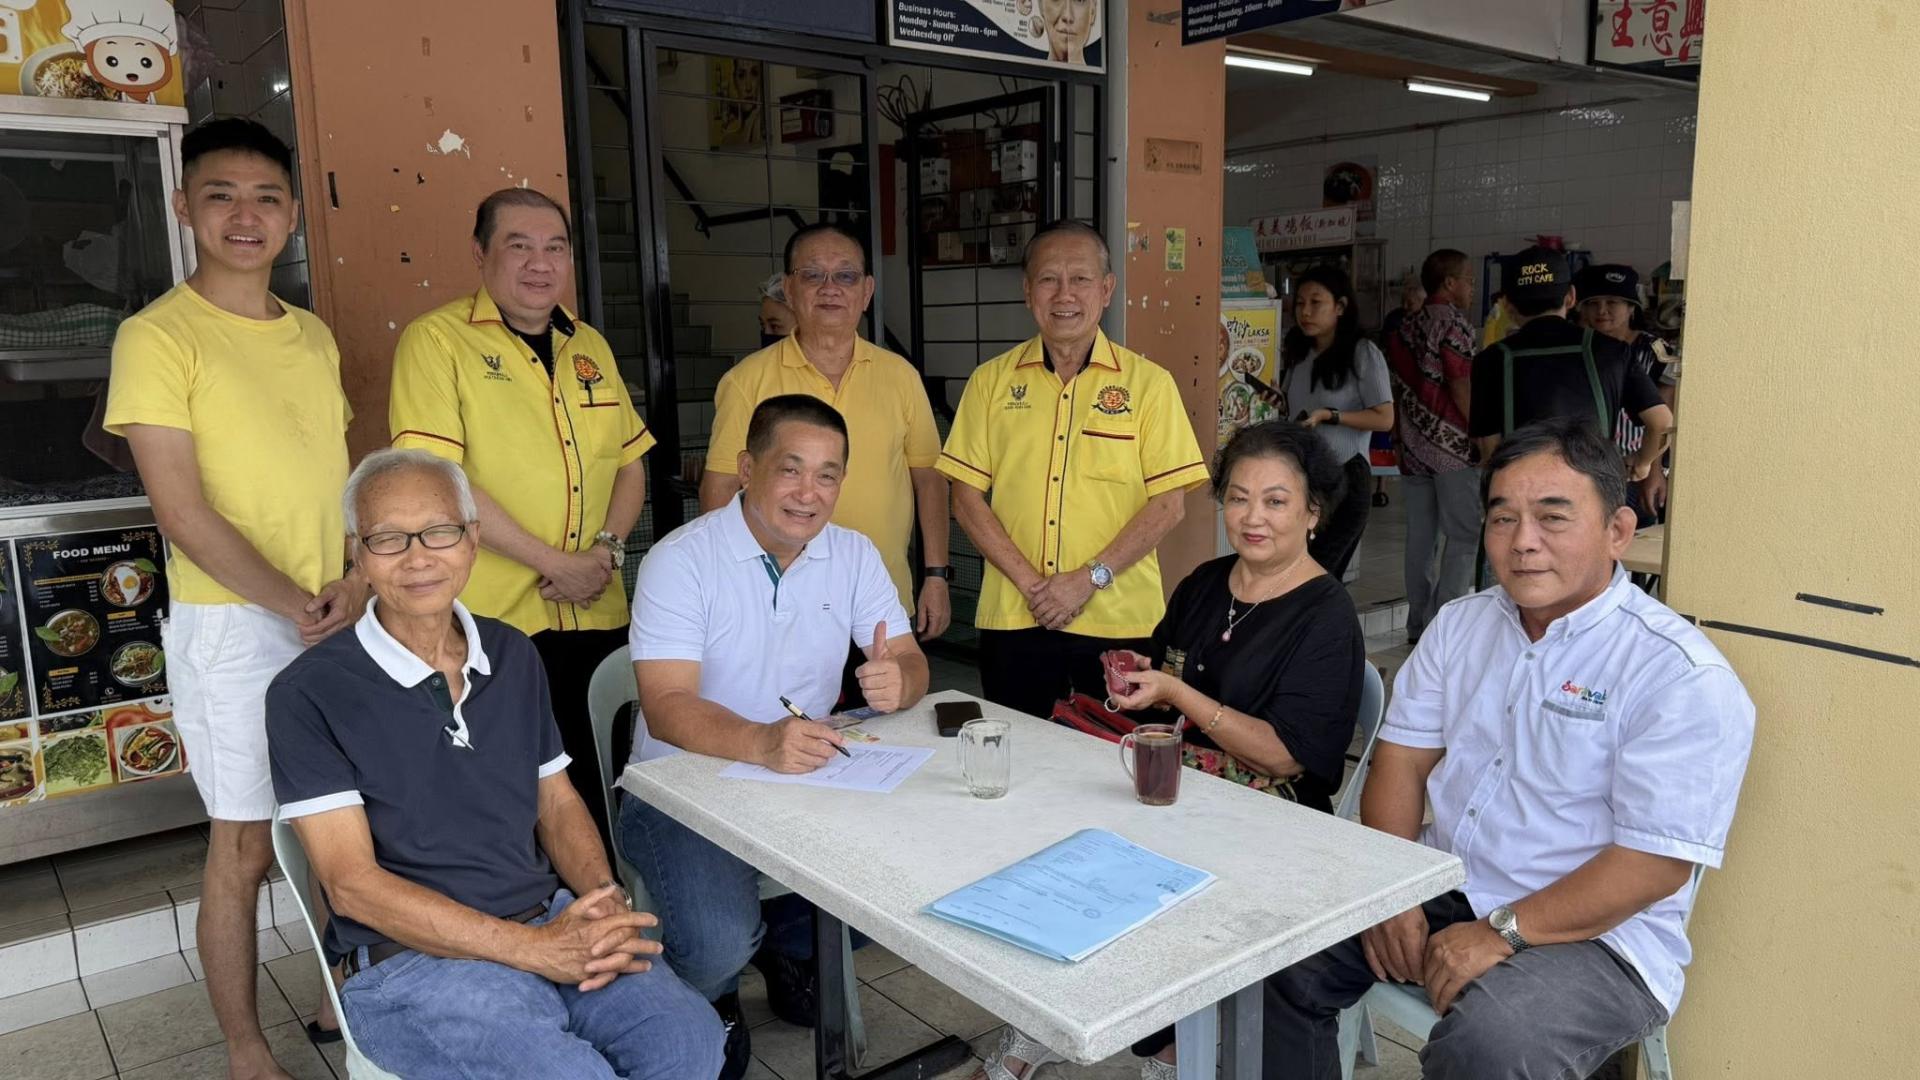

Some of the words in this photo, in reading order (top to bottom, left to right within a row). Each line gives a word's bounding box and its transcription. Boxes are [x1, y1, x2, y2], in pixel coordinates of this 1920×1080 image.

[899, 2, 931, 15] Business
[933, 7, 956, 18] Hours:
[1188, 2, 1217, 15] Business
[899, 15, 928, 28] Monday
[933, 20, 960, 32] Sunday,
[961, 24, 979, 34] 10am
[984, 28, 998, 37] 6pm
[1188, 14, 1214, 26] Monday
[900, 27, 941, 41] Wednesday
[1188, 23, 1226, 37] Wednesday
[1522, 263, 1549, 275] ROCK
[1518, 276, 1532, 286] CITY
[1534, 273, 1554, 283] CAFE
[1248, 328, 1270, 337] LAKSA
[53, 548, 89, 559] FOOD
[93, 544, 131, 555] MENU
